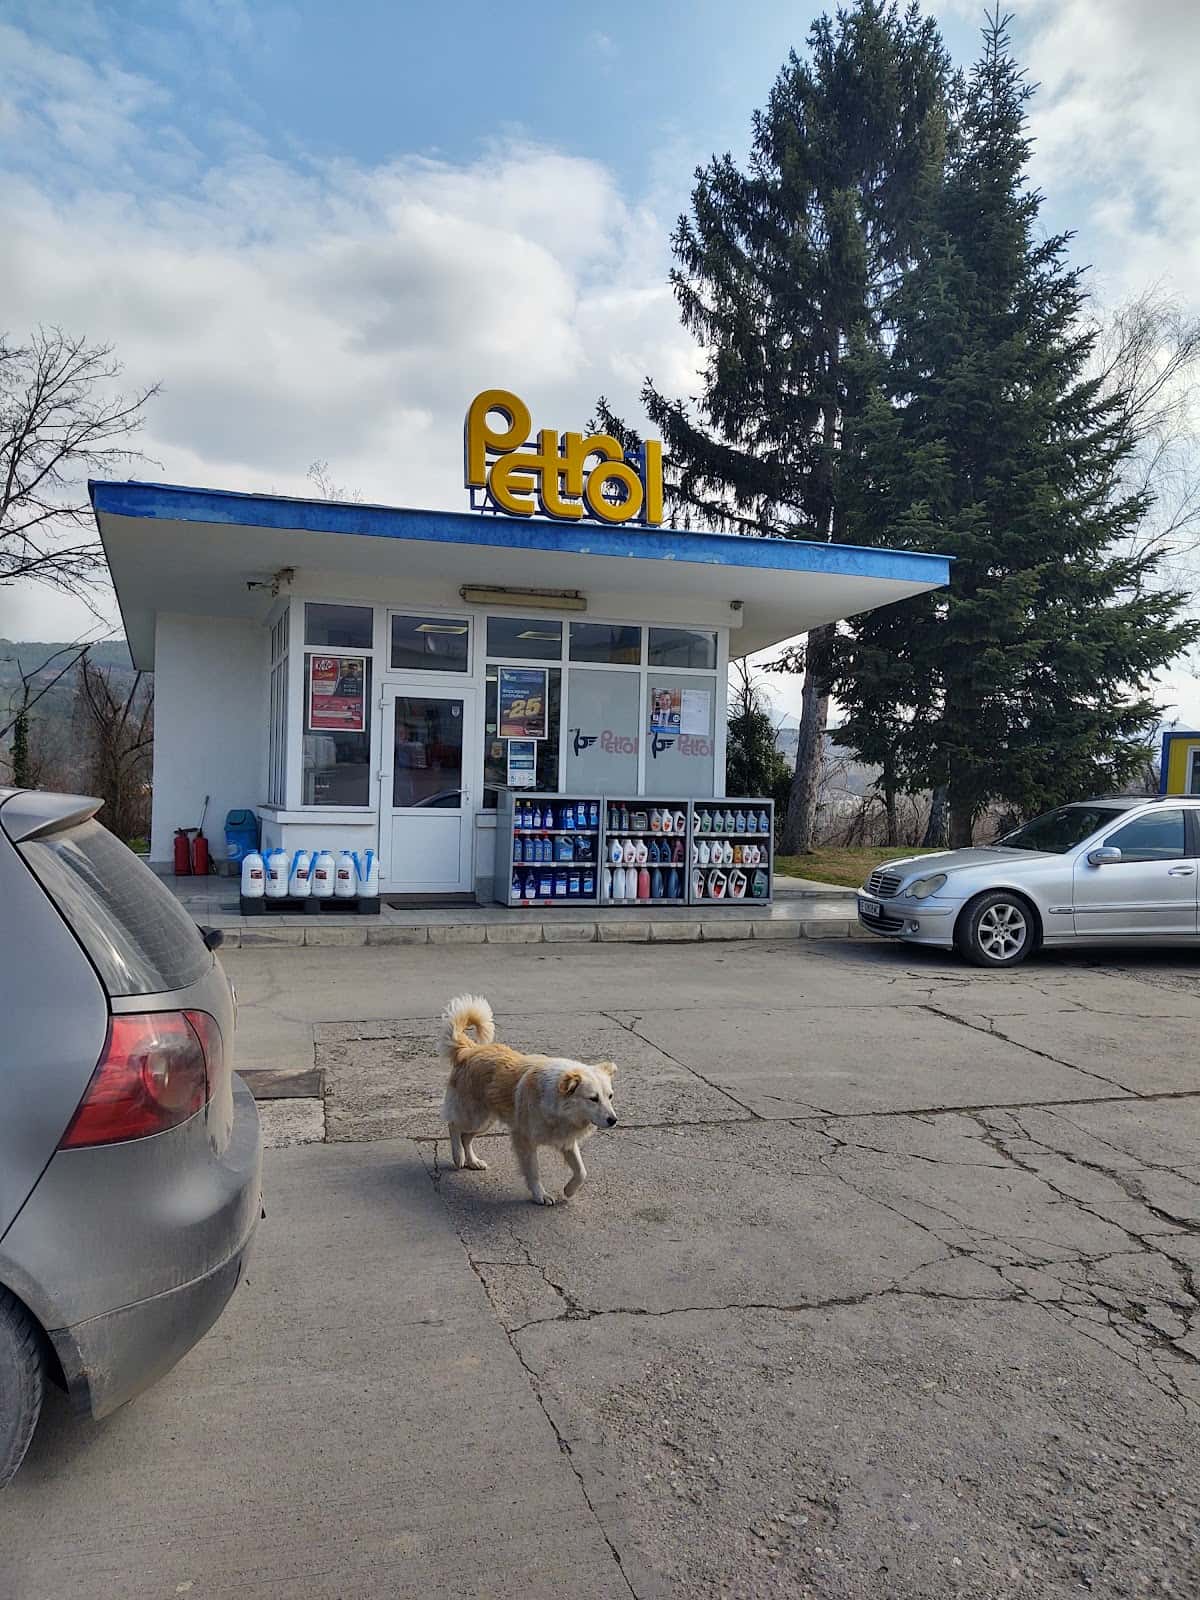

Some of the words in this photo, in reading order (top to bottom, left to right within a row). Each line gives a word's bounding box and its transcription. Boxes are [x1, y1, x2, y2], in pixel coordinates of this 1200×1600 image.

[465, 389, 662, 526] Petrol
[601, 730, 638, 755] Petrol
[677, 735, 713, 757] Petrol
